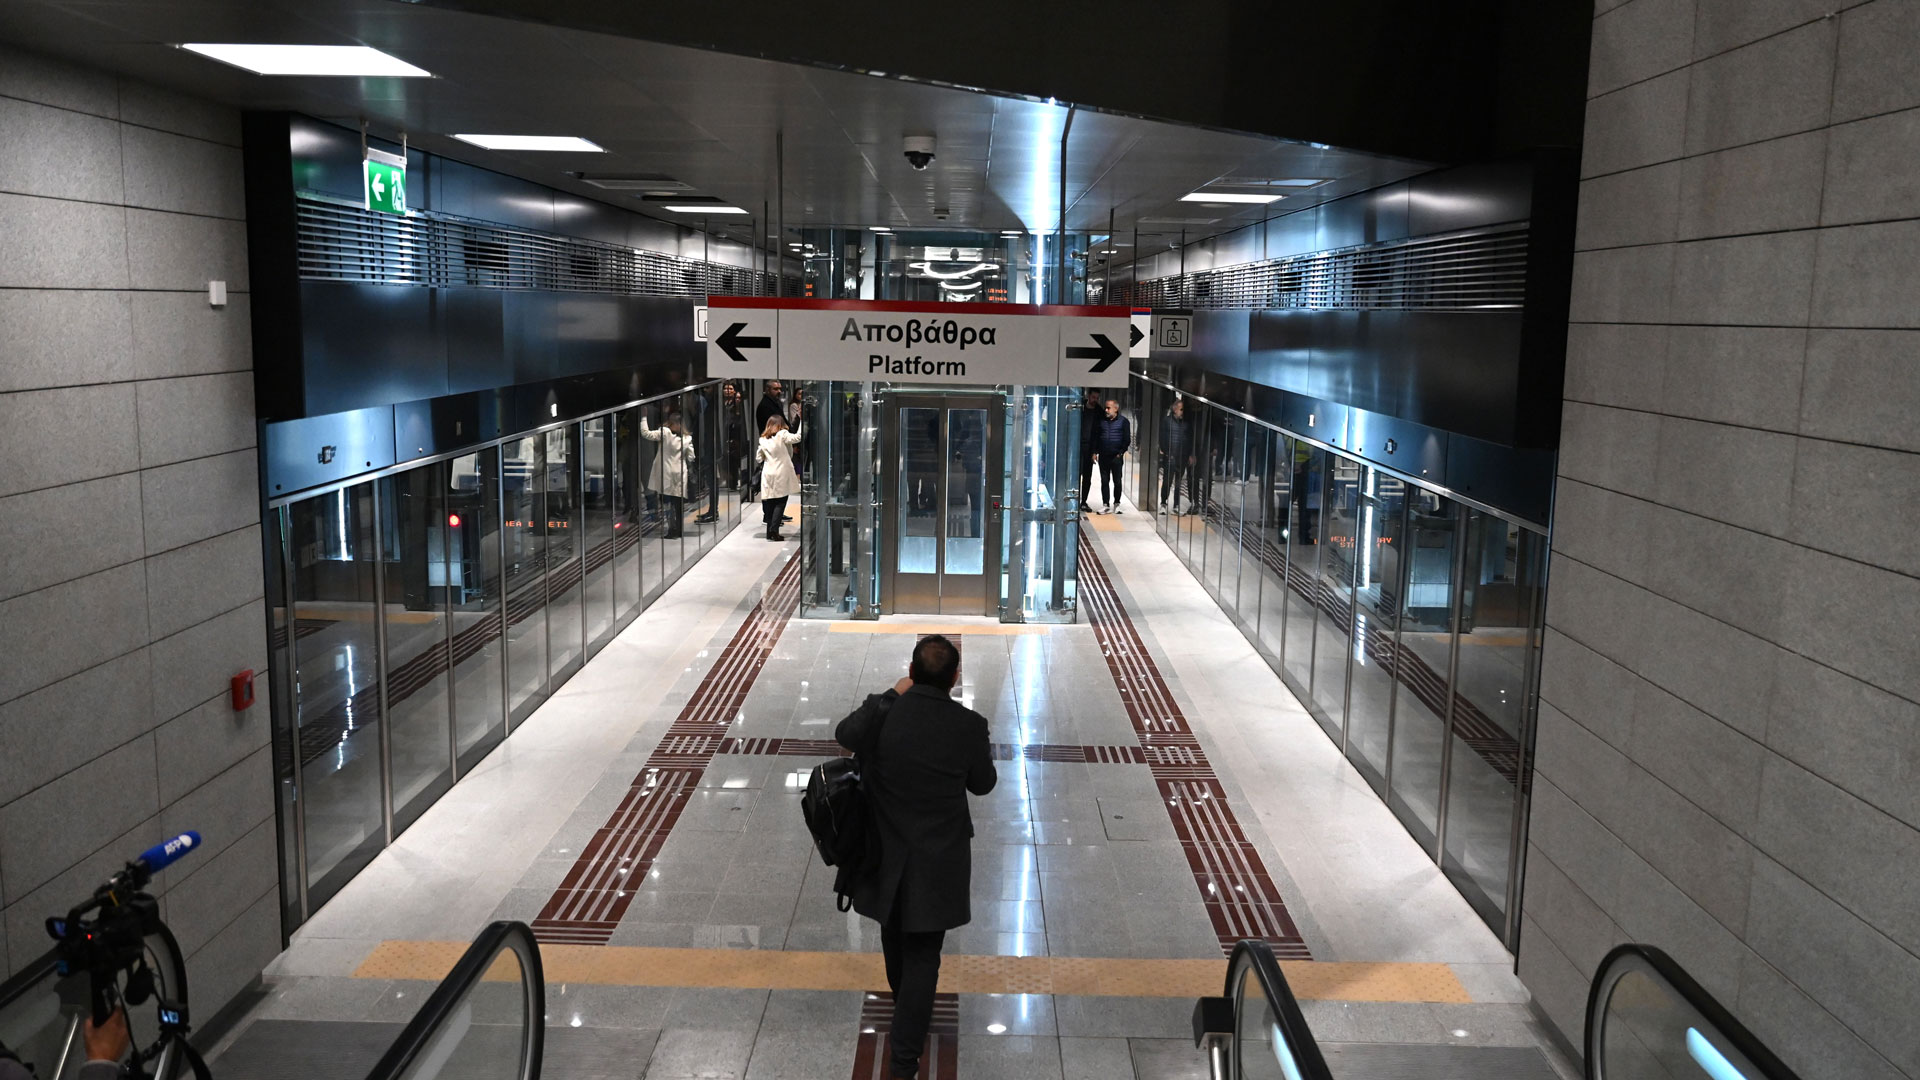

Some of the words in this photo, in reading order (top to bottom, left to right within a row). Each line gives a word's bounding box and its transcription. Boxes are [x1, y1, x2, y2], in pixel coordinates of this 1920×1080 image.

[840, 317, 996, 349] Αποβάθρα
[869, 354, 967, 377] Platform
[164, 839, 182, 856] AFP
